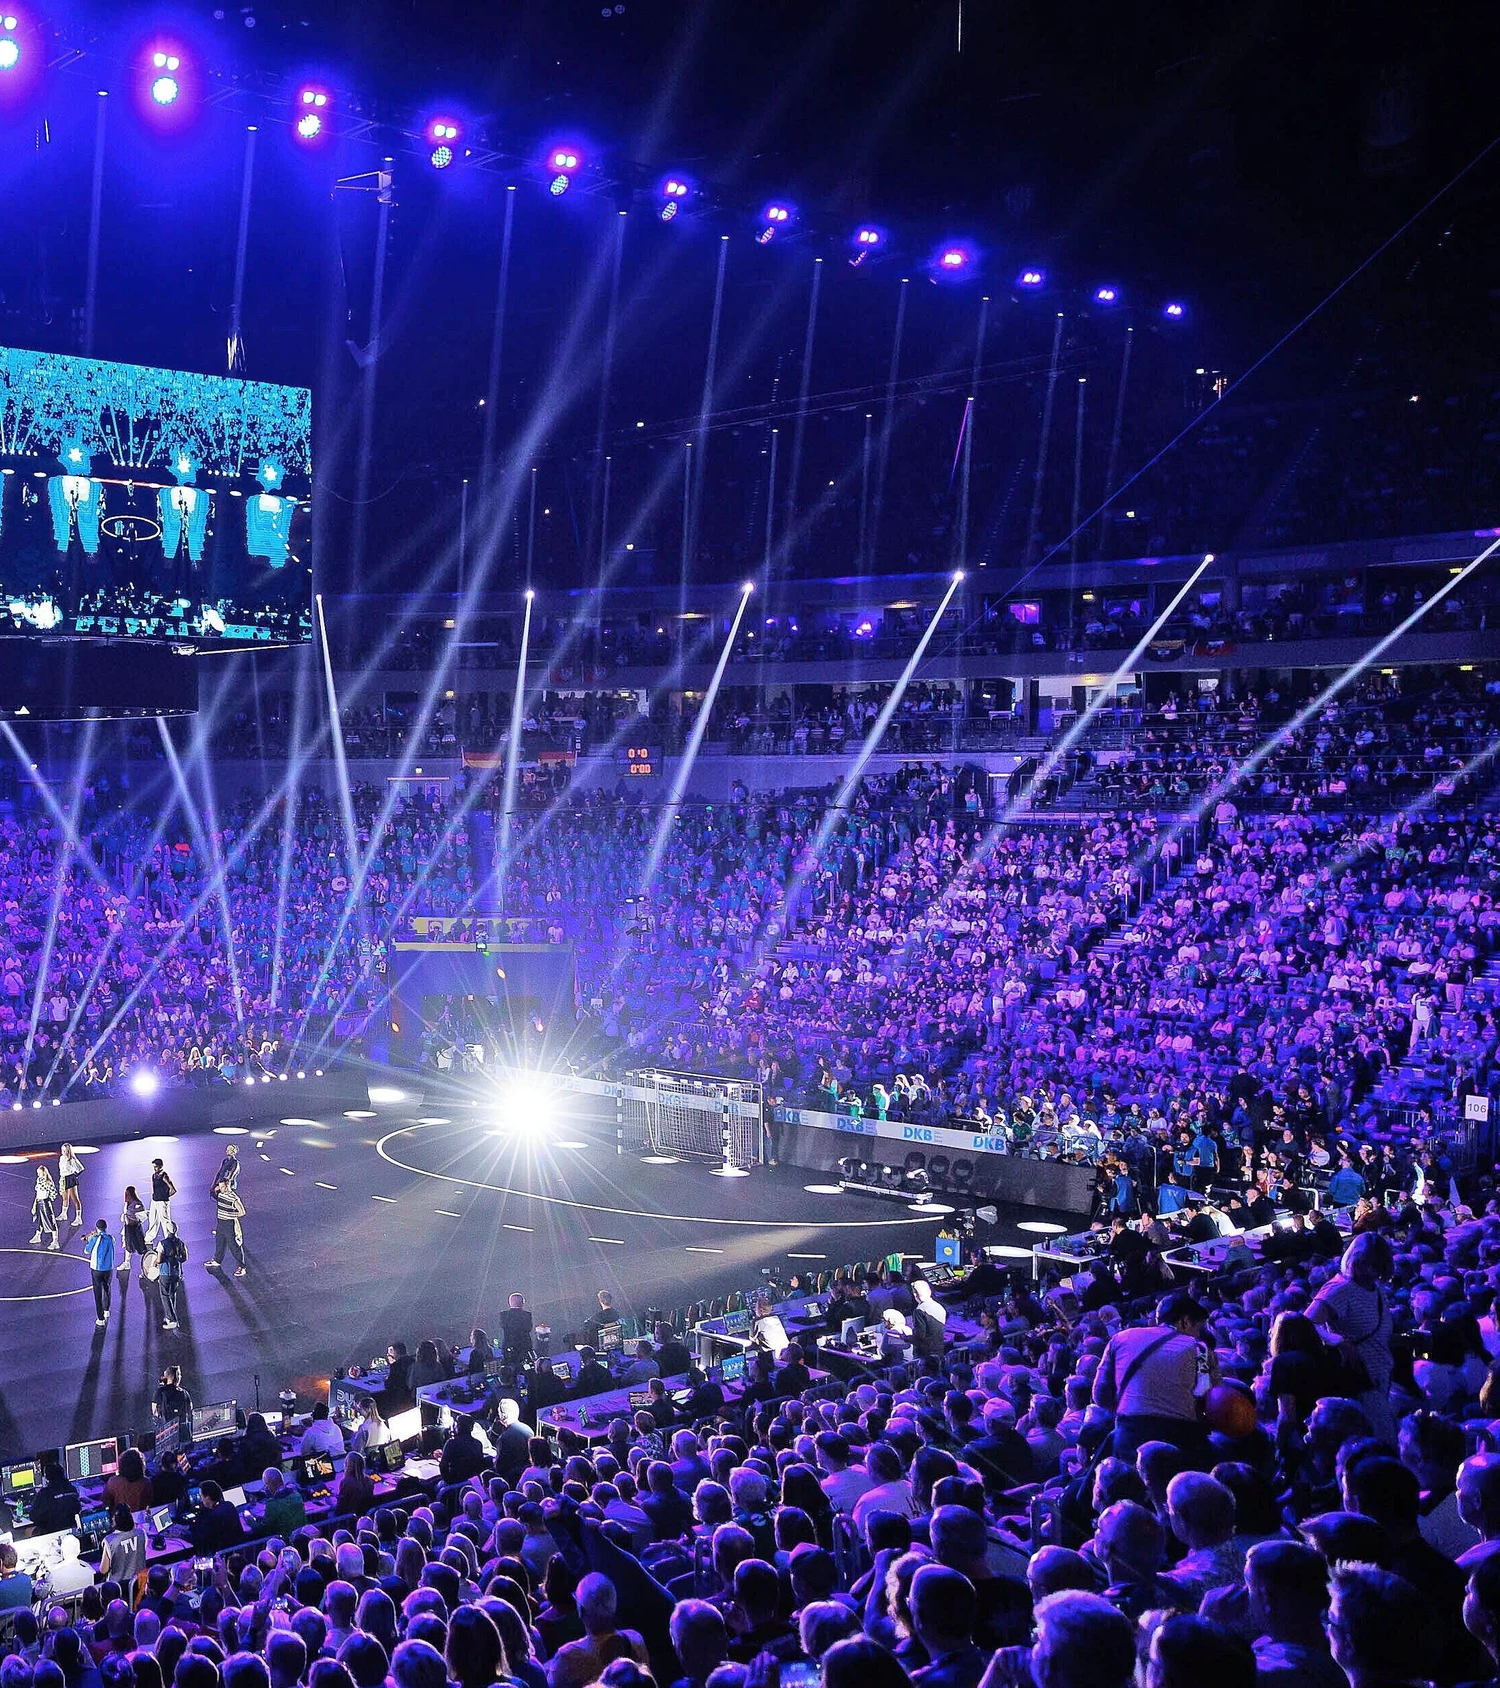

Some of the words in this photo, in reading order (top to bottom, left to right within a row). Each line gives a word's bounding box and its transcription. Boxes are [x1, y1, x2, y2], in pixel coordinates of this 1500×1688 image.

[1468, 1104, 1487, 1113] 106
[903, 1126, 932, 1141] DKB
[973, 1136, 1005, 1151] DKB
[120, 1536, 138, 1554] TV
